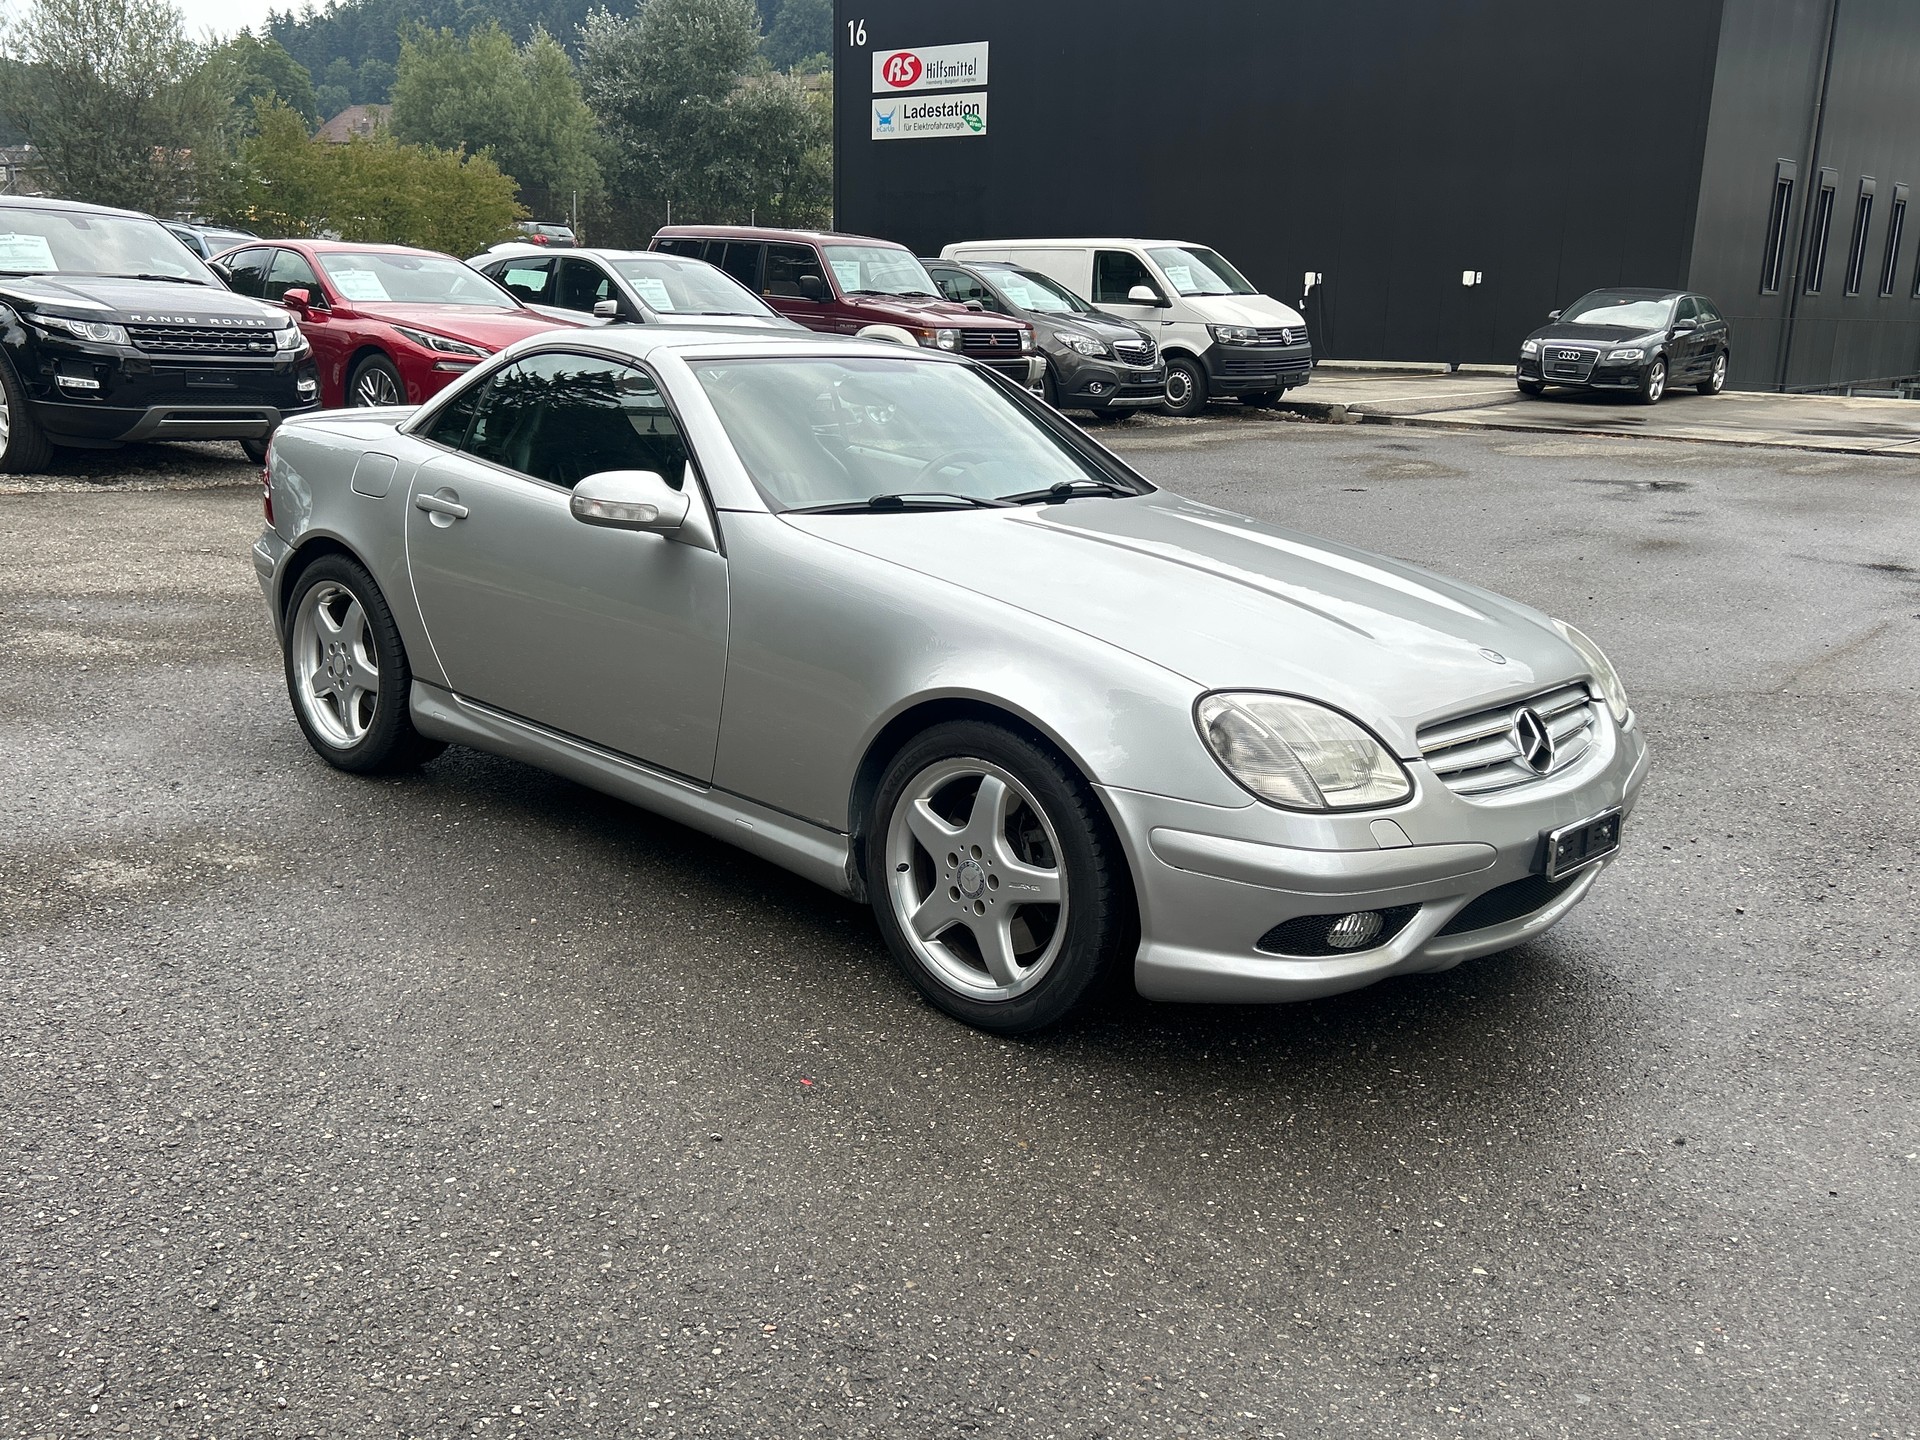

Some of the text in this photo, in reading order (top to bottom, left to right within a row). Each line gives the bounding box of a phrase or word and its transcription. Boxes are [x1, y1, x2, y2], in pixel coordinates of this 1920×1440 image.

[847, 19, 867, 47] 16
[887, 56, 915, 82] RS
[926, 57, 977, 79] Hilfsmittel
[903, 100, 980, 119] Ladestation
[903, 121, 965, 131] für Elektrofahrzeuge
[130, 314, 267, 326] RANGE ROVER
